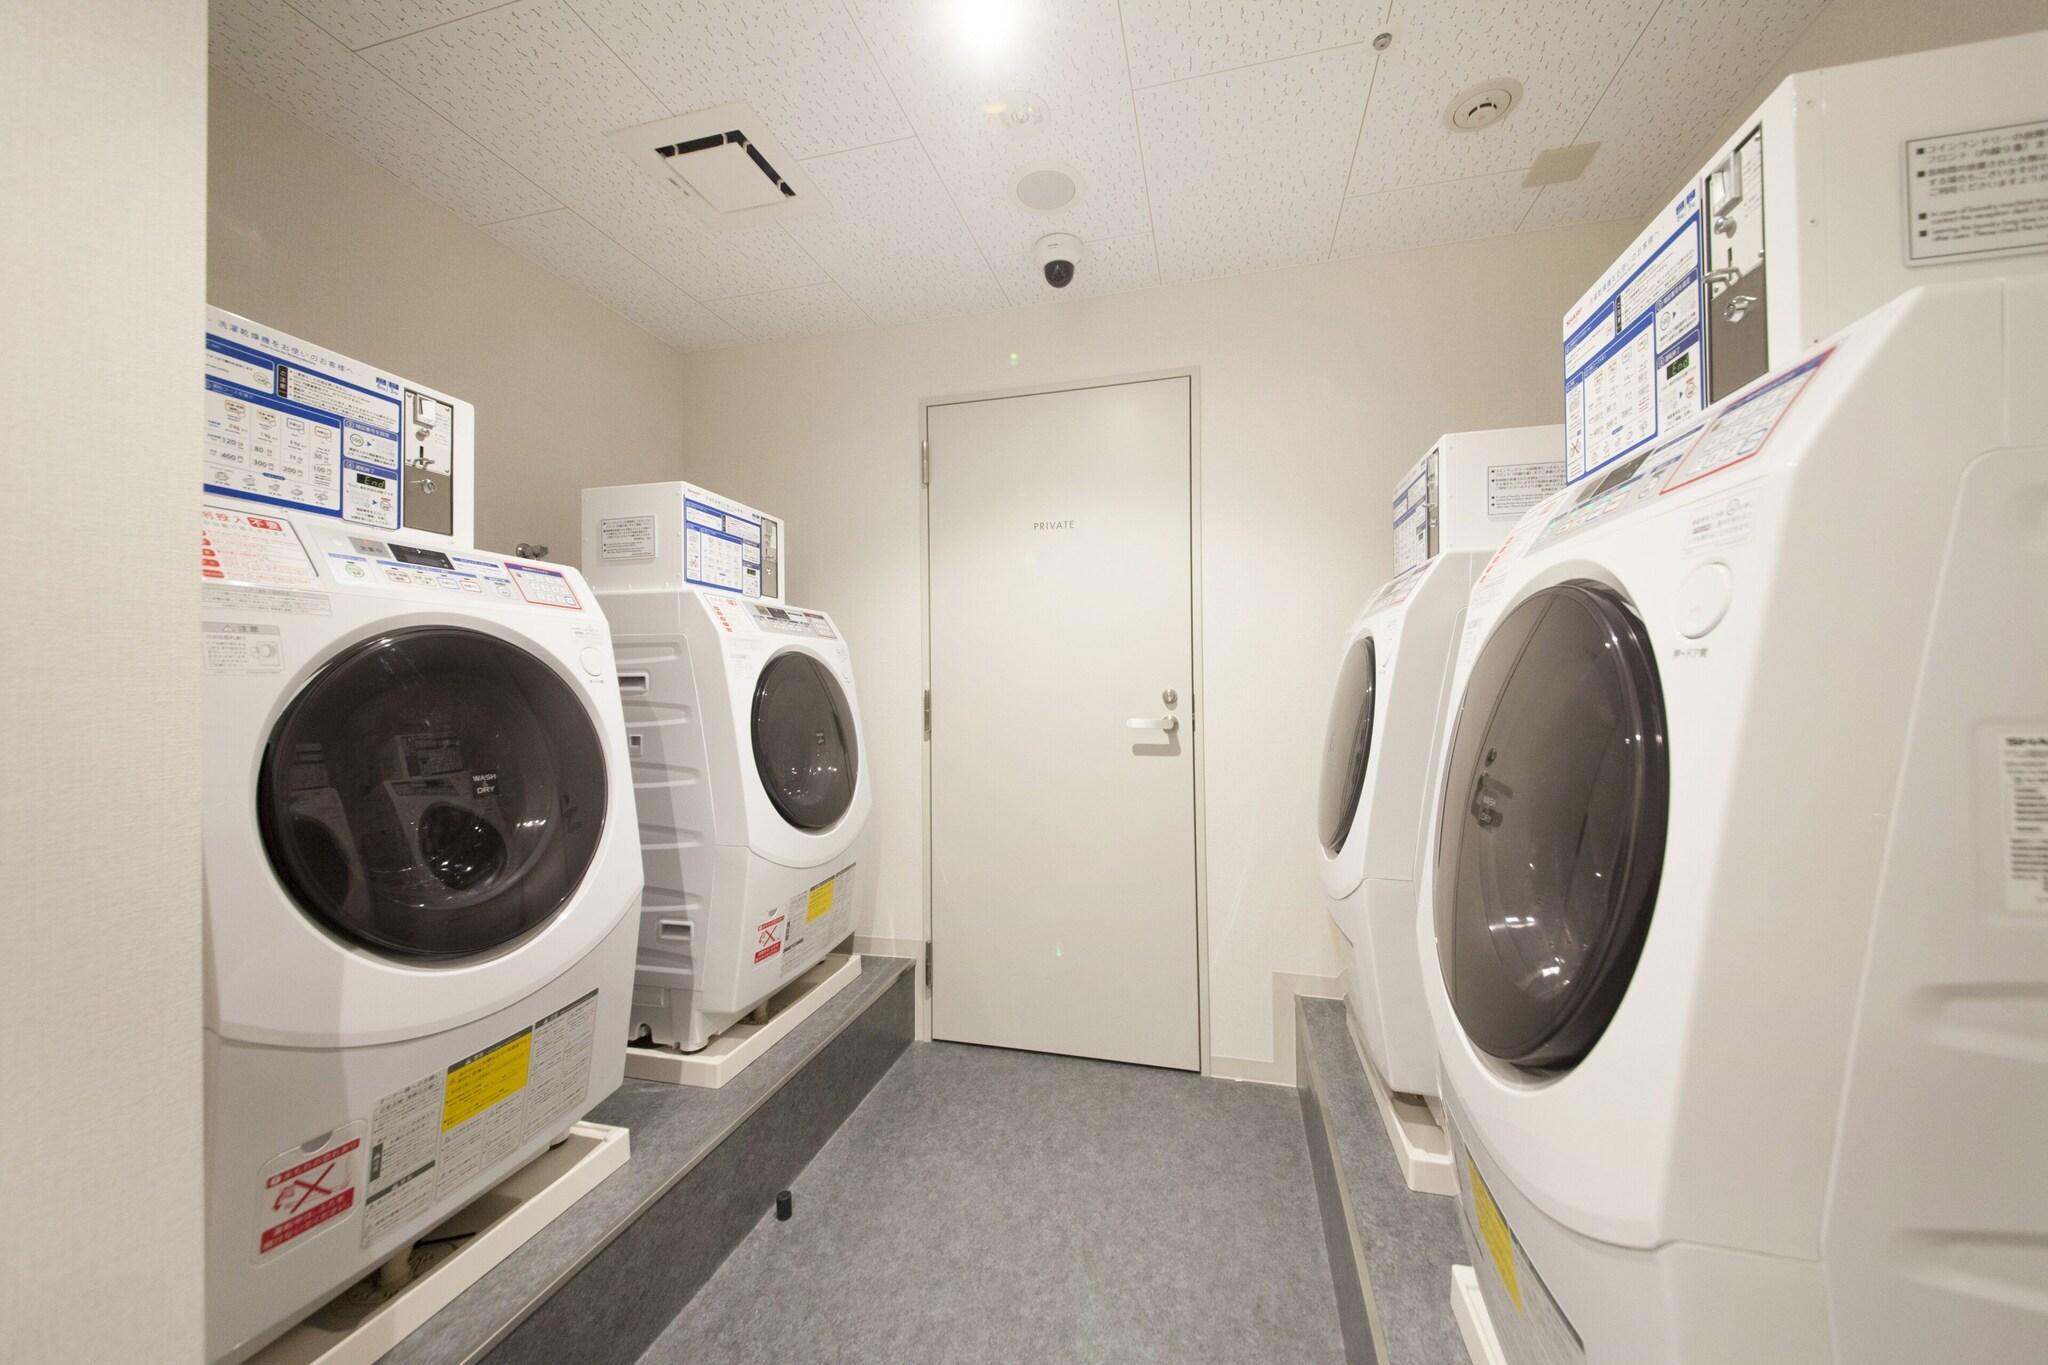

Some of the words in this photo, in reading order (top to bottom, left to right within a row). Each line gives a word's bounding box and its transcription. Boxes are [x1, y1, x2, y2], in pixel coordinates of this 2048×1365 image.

[364, 476, 385, 489] End
[1033, 520, 1075, 530] PRIVATE
[472, 773, 497, 782] WASH
[476, 785, 496, 794] DRY
